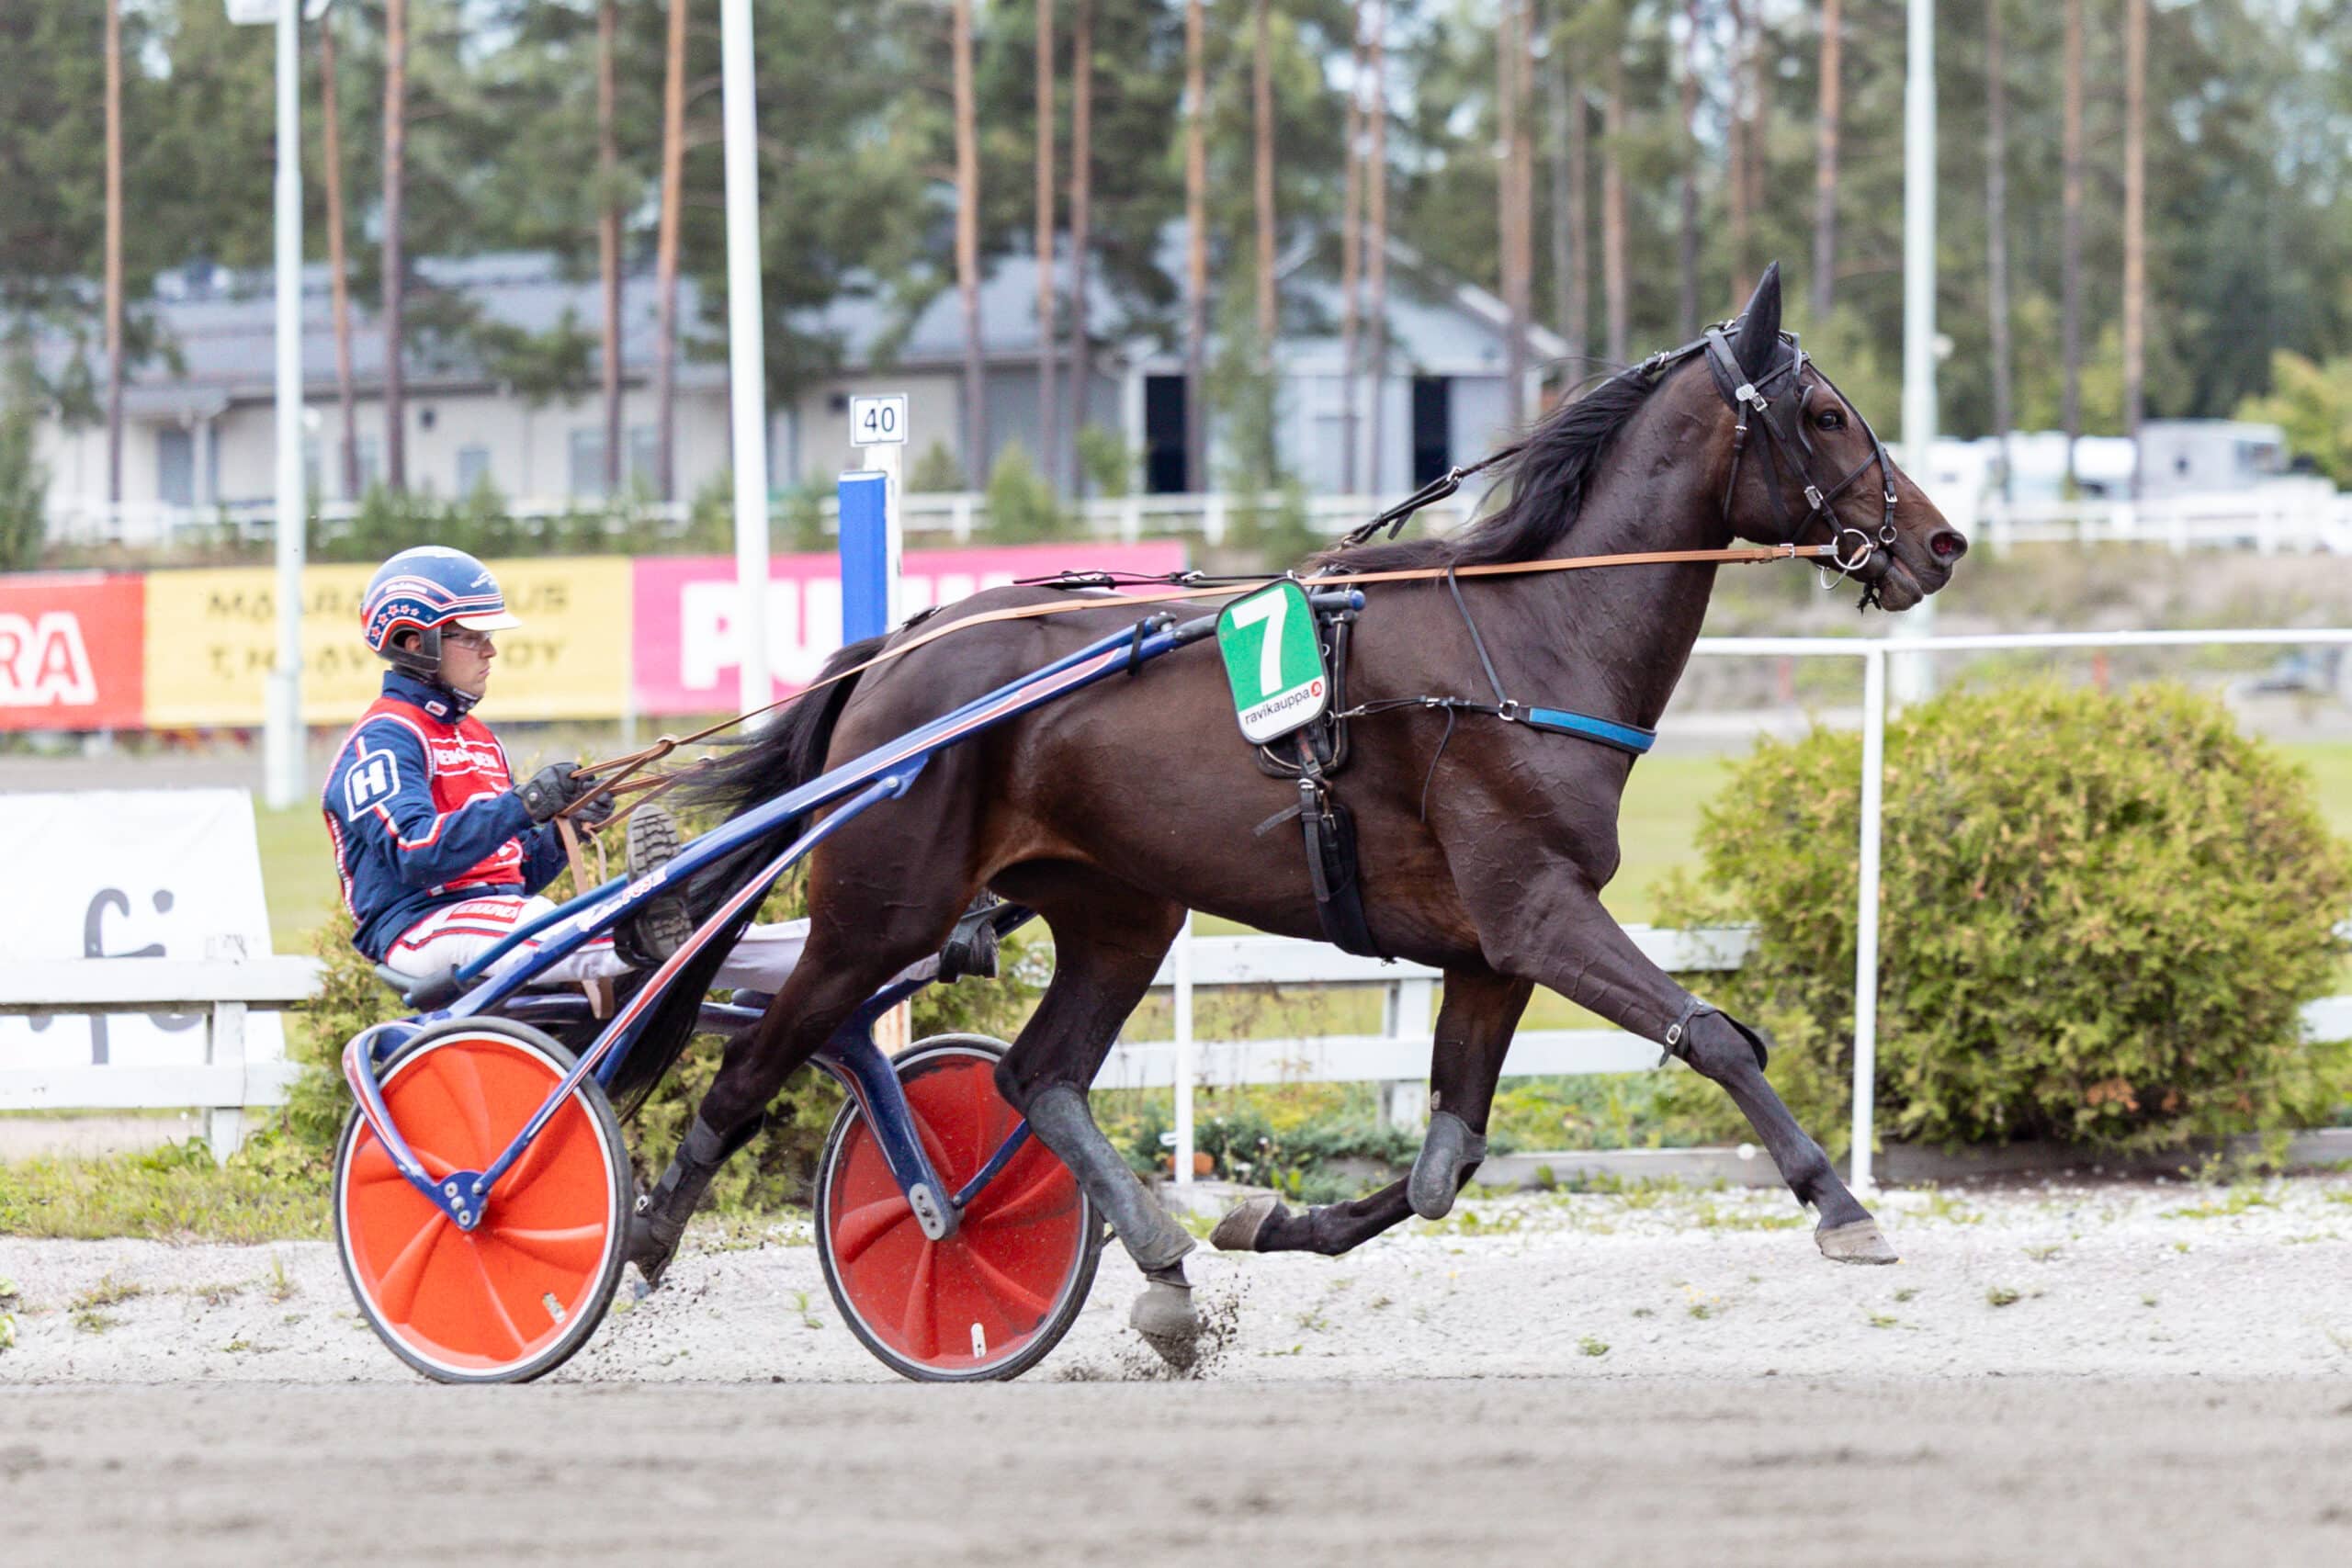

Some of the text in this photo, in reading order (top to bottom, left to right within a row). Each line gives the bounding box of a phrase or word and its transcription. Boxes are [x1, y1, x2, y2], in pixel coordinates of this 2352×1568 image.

[864, 406, 896, 433] 40
[1230, 587, 1289, 697] 7
[1244, 688, 1311, 725] ravikauppa
[351, 759, 388, 807] H
